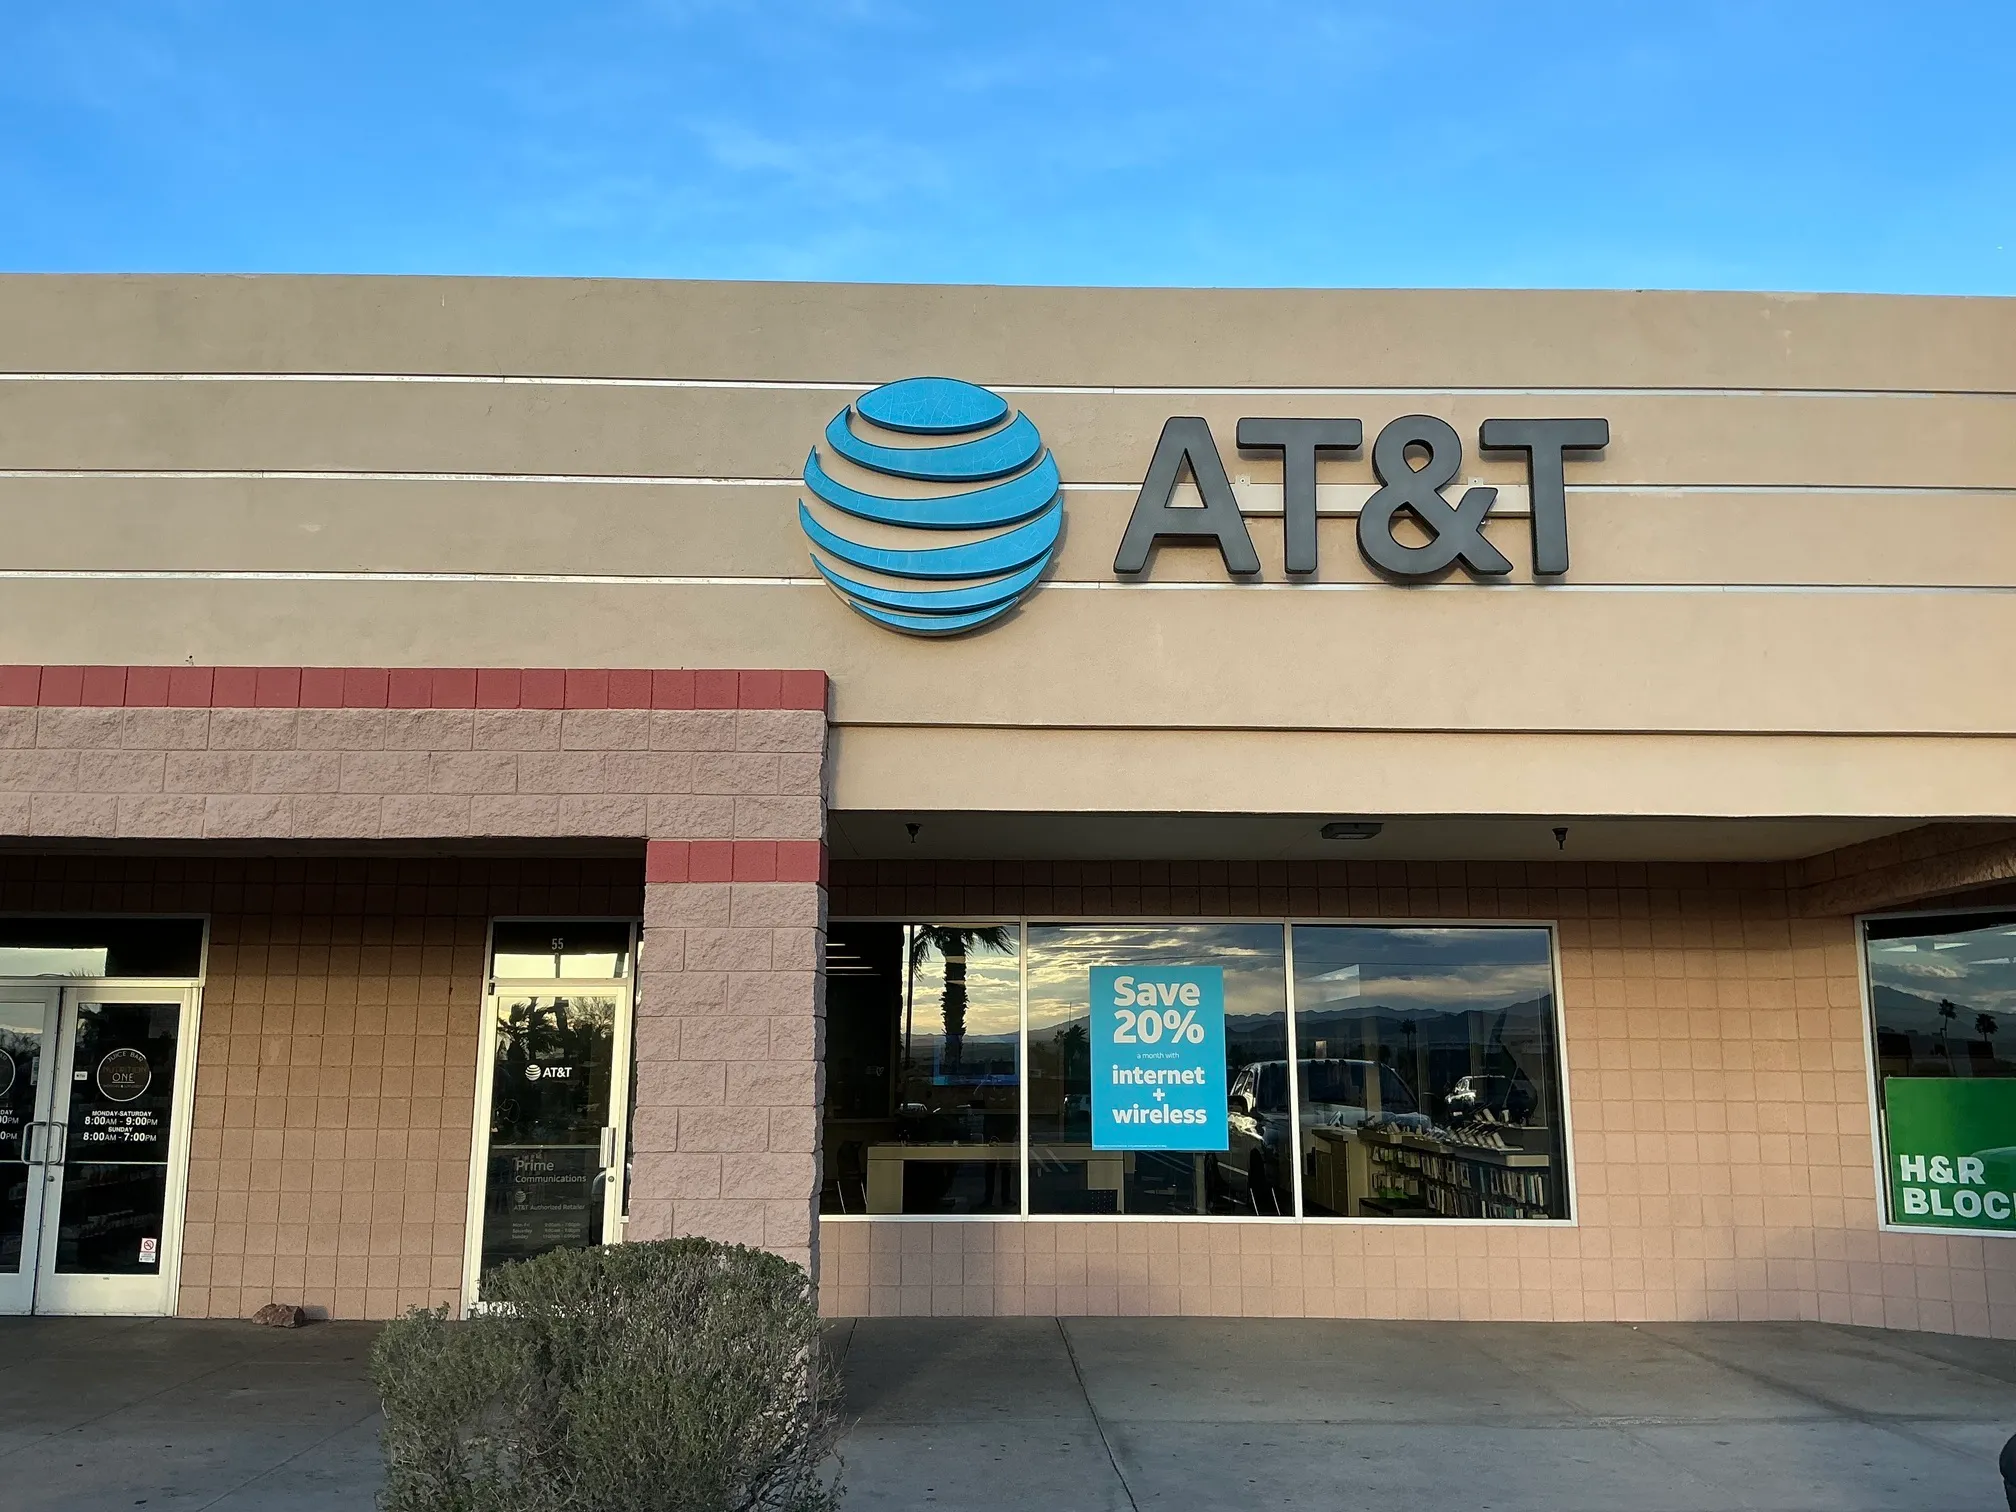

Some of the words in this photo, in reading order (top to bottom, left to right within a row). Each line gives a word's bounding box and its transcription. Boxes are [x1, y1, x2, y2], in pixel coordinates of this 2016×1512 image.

[1114, 414, 1610, 578] AT&T
[551, 937, 564, 950] 55
[1113, 975, 1201, 1007] Save
[1113, 1009, 1205, 1044] 20%
[107, 1051, 127, 1063] JUICE
[129, 1052, 144, 1063] BAR
[112, 1072, 135, 1082] ONE
[542, 1067, 573, 1078] AT&T
[1112, 1064, 1206, 1085] internet
[1112, 1103, 1208, 1125] wireless
[84, 1116, 117, 1125] 8:00AM
[125, 1117, 158, 1126] 9:00PM
[83, 1132, 117, 1141] 8:00AM
[123, 1133, 157, 1142] 7:00PM
[516, 1159, 555, 1171] Prime
[1900, 1154, 1986, 1185] H&R
[515, 1174, 587, 1183] Communications
[1903, 1187, 2016, 1220] BLOC
